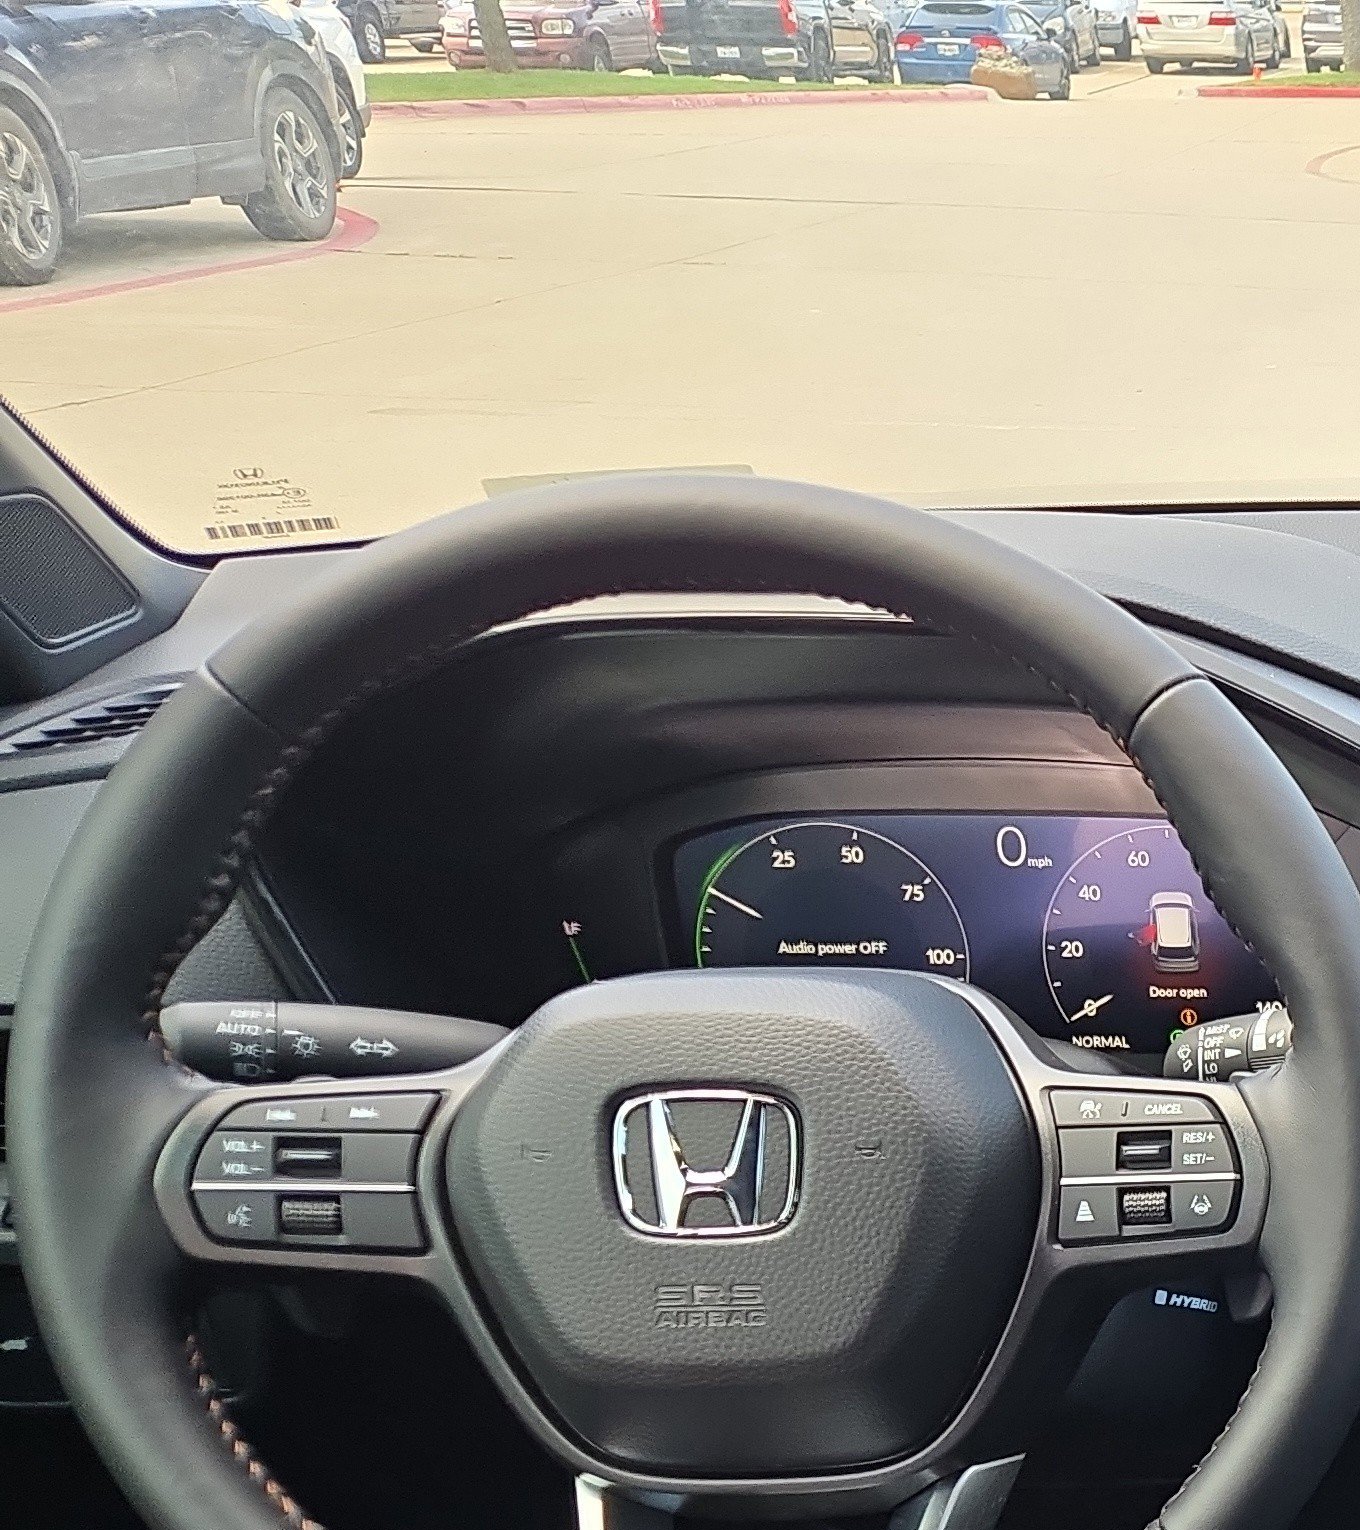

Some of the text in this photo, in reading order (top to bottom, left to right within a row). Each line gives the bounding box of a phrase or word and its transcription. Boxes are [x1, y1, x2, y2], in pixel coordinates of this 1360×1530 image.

[840, 845, 865, 864] 50
[995, 825, 1054, 870] 0 mph
[771, 850, 797, 869] 25
[1127, 850, 1151, 867] 60
[900, 884, 925, 902] 75
[1078, 885, 1102, 901] 40
[777, 940, 889, 956] Audio power OFF
[1060, 941, 1085, 958] 20
[925, 949, 956, 965] 100
[1149, 986, 1208, 1000] Door open
[216, 1022, 263, 1036] AUTO
[1205, 1023, 1231, 1036] MIST
[1072, 1035, 1131, 1049] NORMAL
[1204, 1036, 1225, 1049] OFF
[1204, 1048, 1221, 1061] INT
[1204, 1062, 1218, 1075] LO
[1144, 1103, 1184, 1116] CANCEL
[1182, 1131, 1216, 1144] RES/+
[655, 1283, 763, 1308] SRS
[1168, 1293, 1219, 1314] HYBRID
[655, 1308, 768, 1329] AIRBAG
